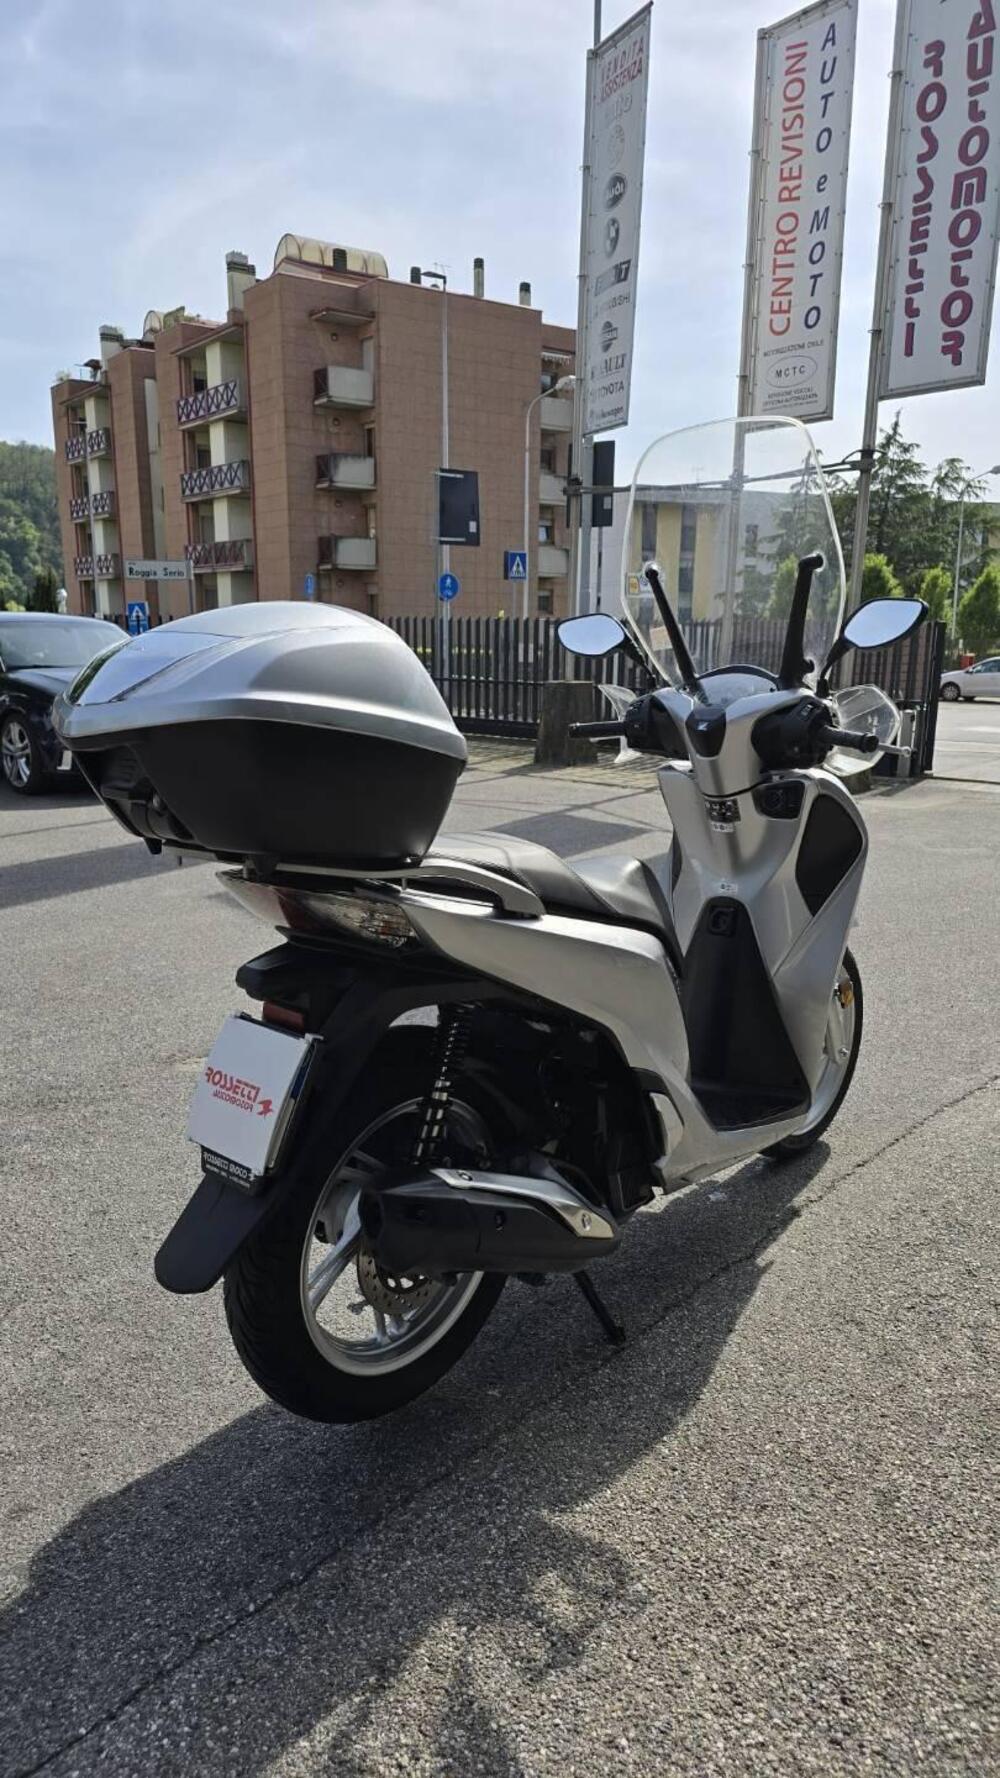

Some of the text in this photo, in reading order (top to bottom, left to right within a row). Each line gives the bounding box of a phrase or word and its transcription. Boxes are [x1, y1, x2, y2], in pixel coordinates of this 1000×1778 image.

[815, 22, 837, 154] AUTO
[769, 40, 809, 337] CENTRO REVISIONI
[905, 39, 948, 358] ROSSETTI
[804, 206, 831, 330] MOTO
[775, 364, 806, 378] MCTC
[128, 566, 158, 577] Roggia
[205, 1067, 261, 1103] ROSSETTI
